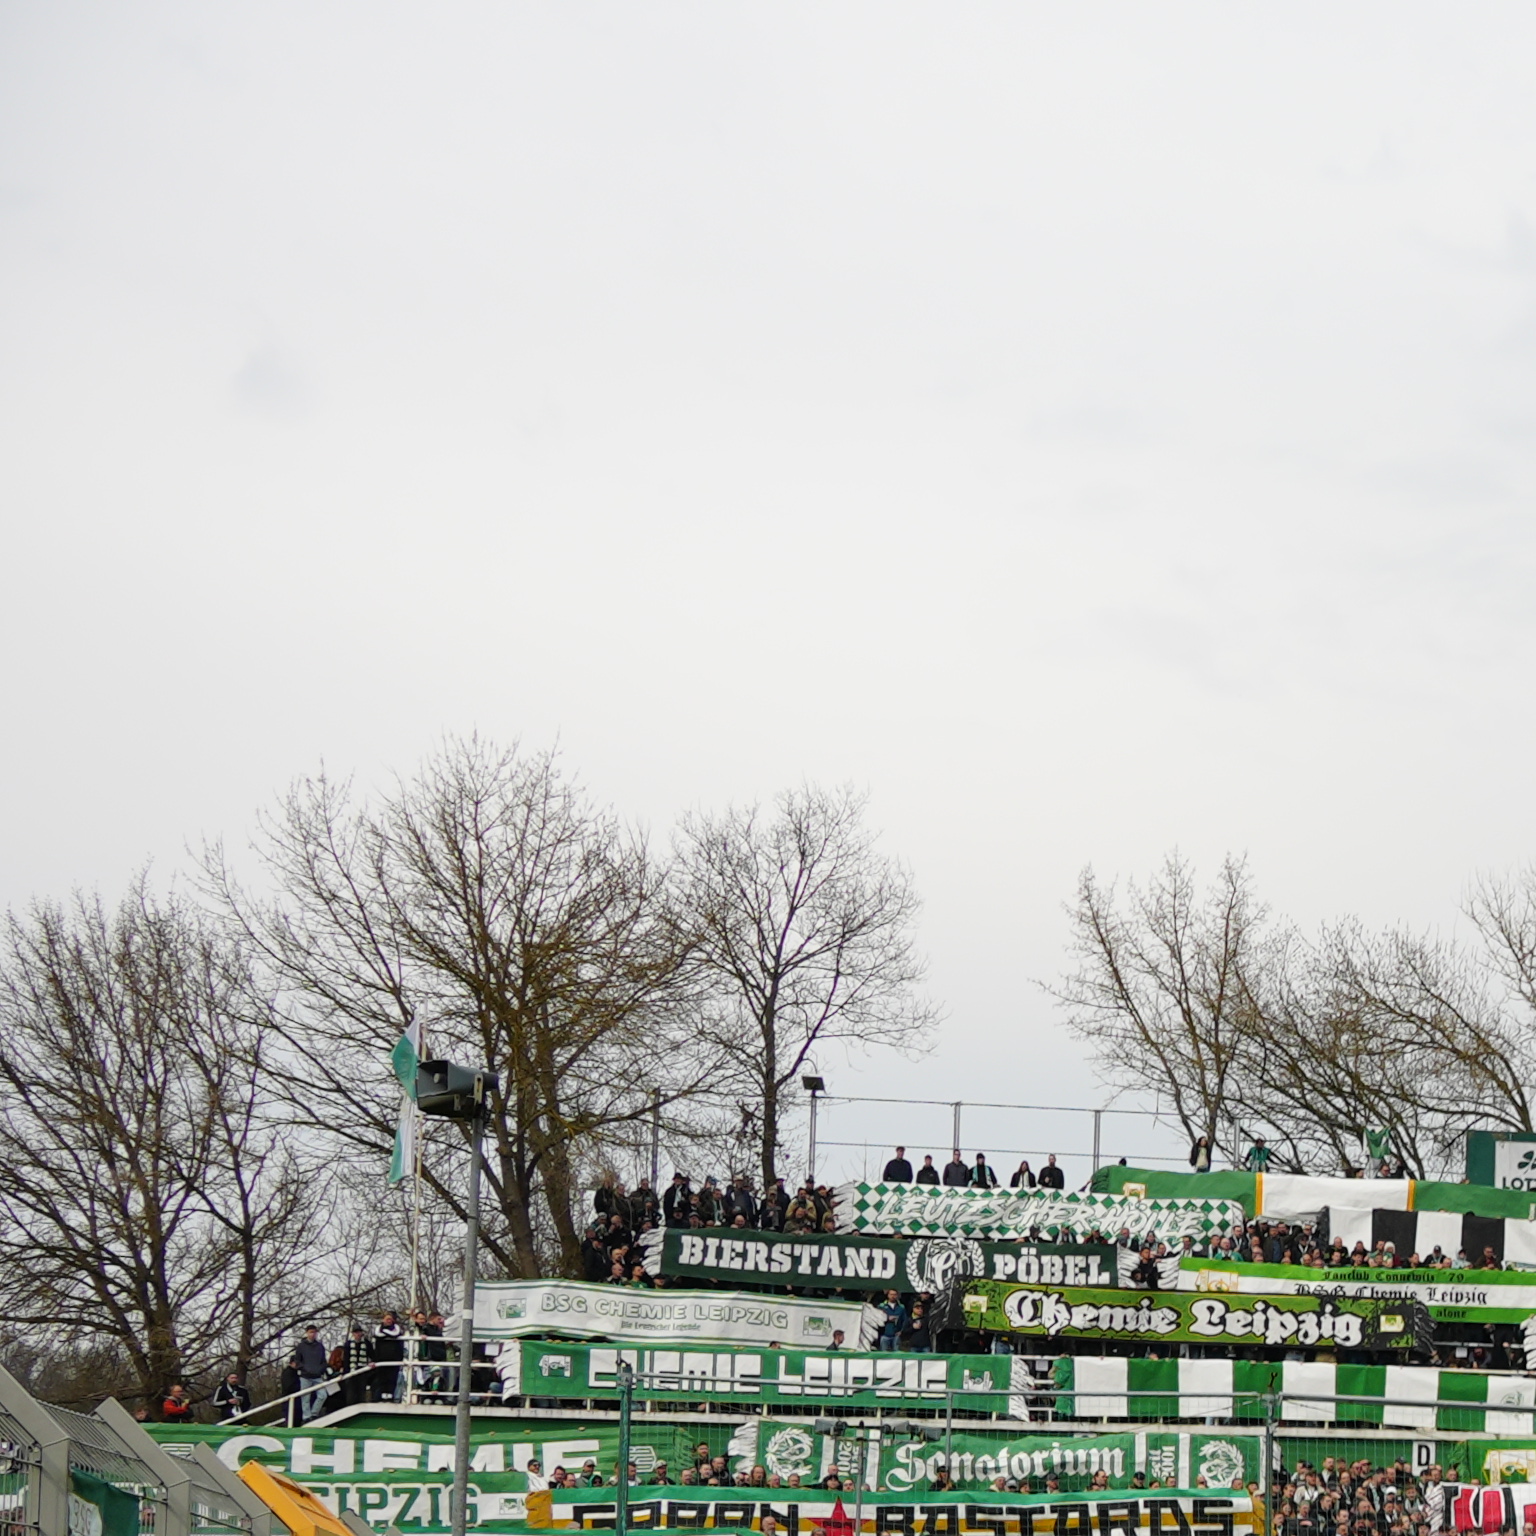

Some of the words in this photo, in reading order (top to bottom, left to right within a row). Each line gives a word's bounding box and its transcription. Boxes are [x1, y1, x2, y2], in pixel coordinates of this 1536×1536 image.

[876, 1190, 1097, 1233] LEUTZSCHER
[678, 1235, 896, 1280] BIERSTAND
[993, 1247, 1110, 1286] PÖBEL
[541, 1293, 587, 1313] BSG
[594, 1298, 687, 1320] CHEMIE
[694, 1303, 788, 1329] LEIPZIG
[1426, 1287, 1489, 1305] Leipzig
[1004, 1289, 1182, 1336] Chemie
[1189, 1298, 1363, 1348] Leipzig
[588, 1348, 763, 1392] CHEMIE
[778, 1354, 948, 1400] LEIPZIG
[218, 1434, 599, 1473] CHEMIE
[886, 1441, 1125, 1493] Sanatorium
[1416, 1444, 1431, 1468] D
